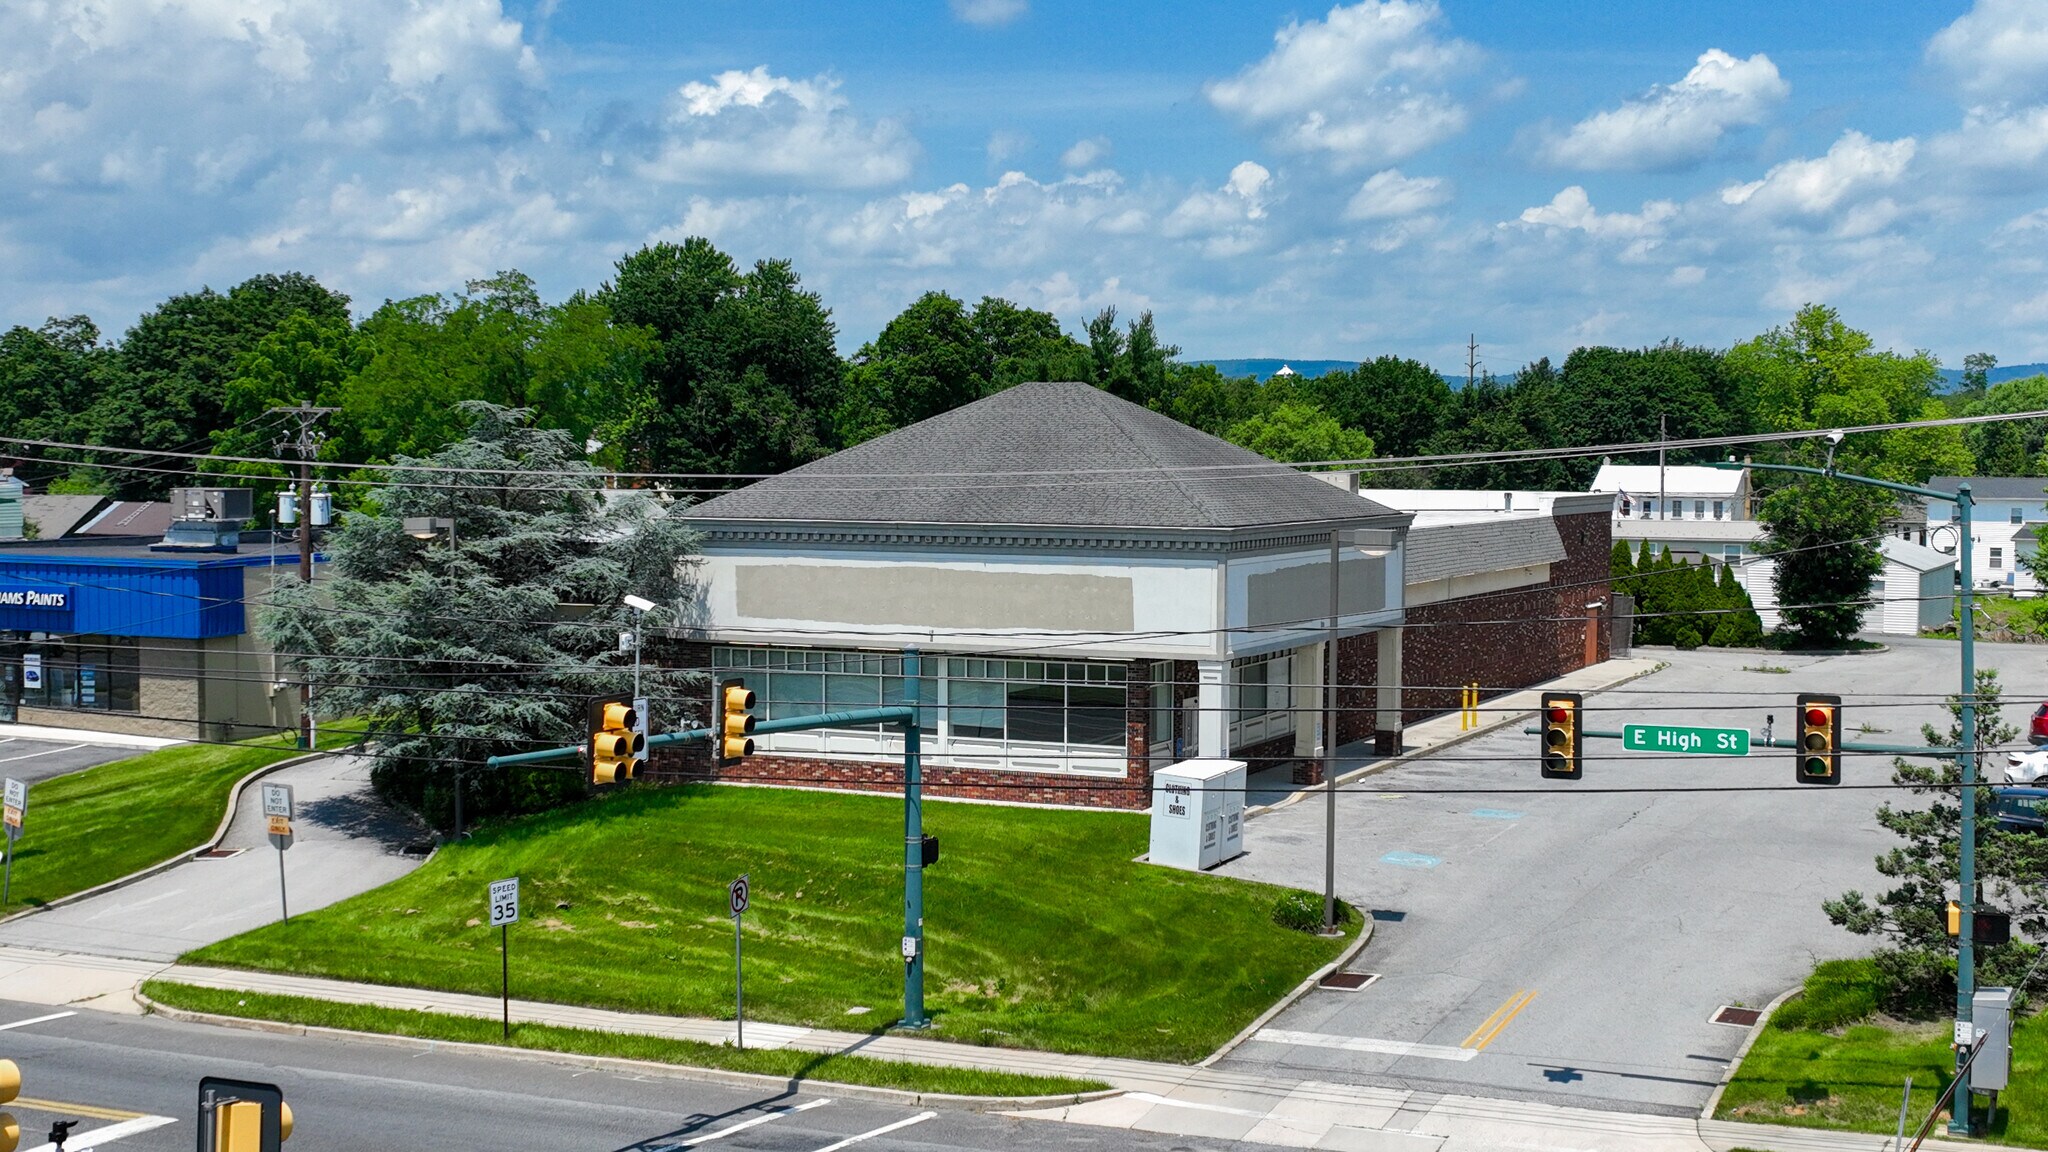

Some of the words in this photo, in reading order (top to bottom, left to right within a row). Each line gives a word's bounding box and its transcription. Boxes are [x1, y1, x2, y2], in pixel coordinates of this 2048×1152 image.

[1634, 729, 1646, 745] E
[1657, 730, 1701, 752] High
[1716, 733, 1738, 750] St
[271, 789, 281, 797] DO
[5, 796, 22, 806] ENTER
[270, 797, 282, 805] NOT
[267, 804, 287, 814] ENTER
[1168, 804, 1186, 816] SHOES
[492, 883, 516, 895] SPEED
[494, 892, 514, 903] LIMIT
[494, 901, 516, 921] 35
